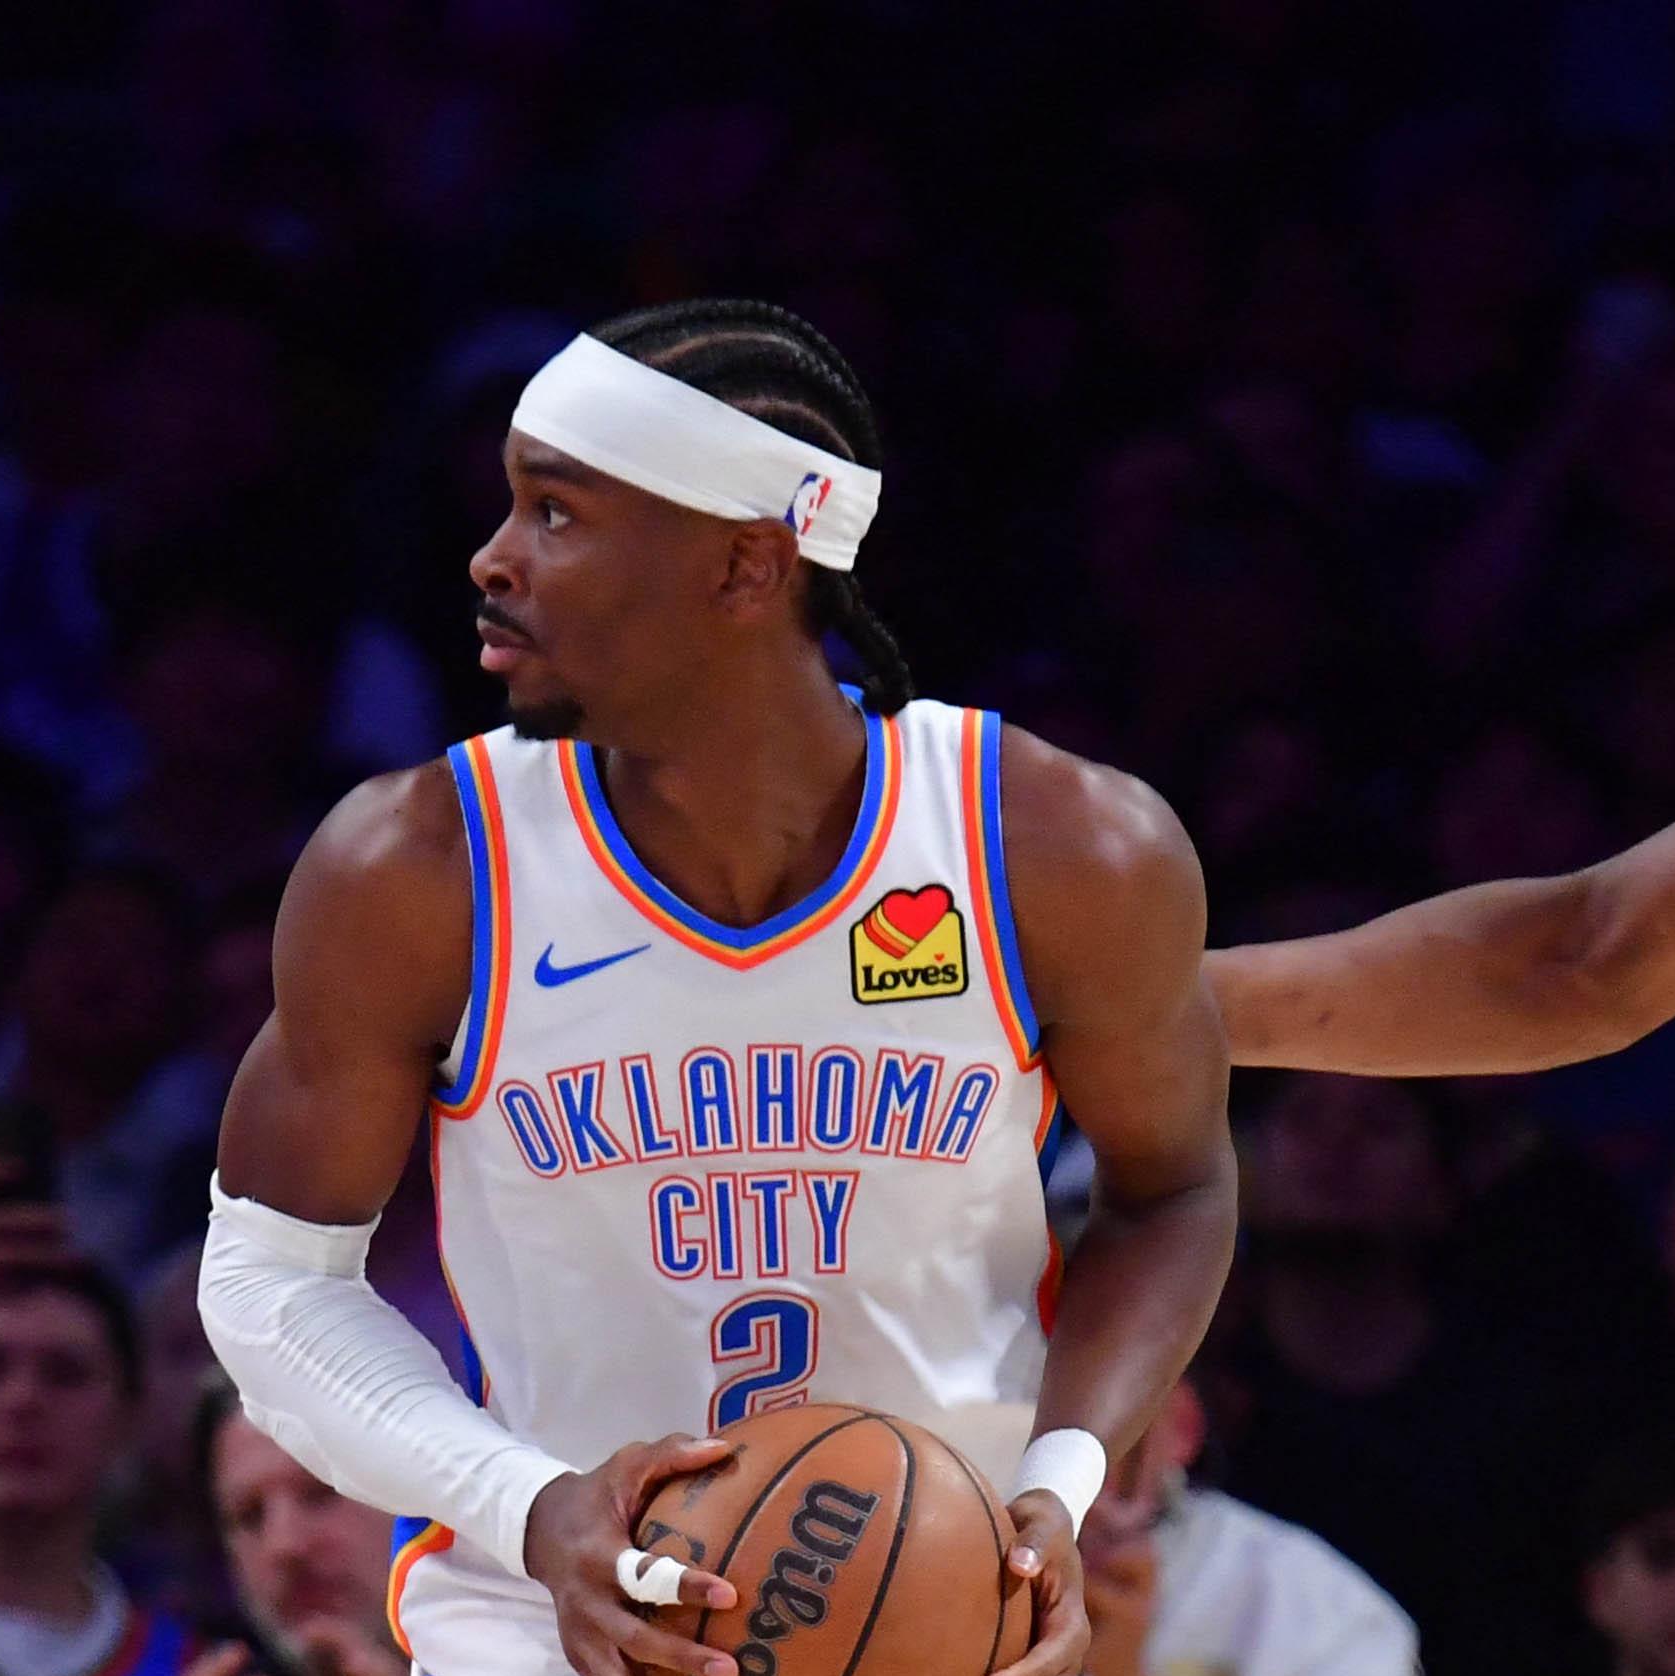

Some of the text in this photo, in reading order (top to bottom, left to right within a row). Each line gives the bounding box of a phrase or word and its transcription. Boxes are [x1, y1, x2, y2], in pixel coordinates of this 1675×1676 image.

[496, 1044, 1000, 1178] OKLAHOMA
[648, 1170, 860, 1281] CITY
[707, 1290, 819, 1438] 2
